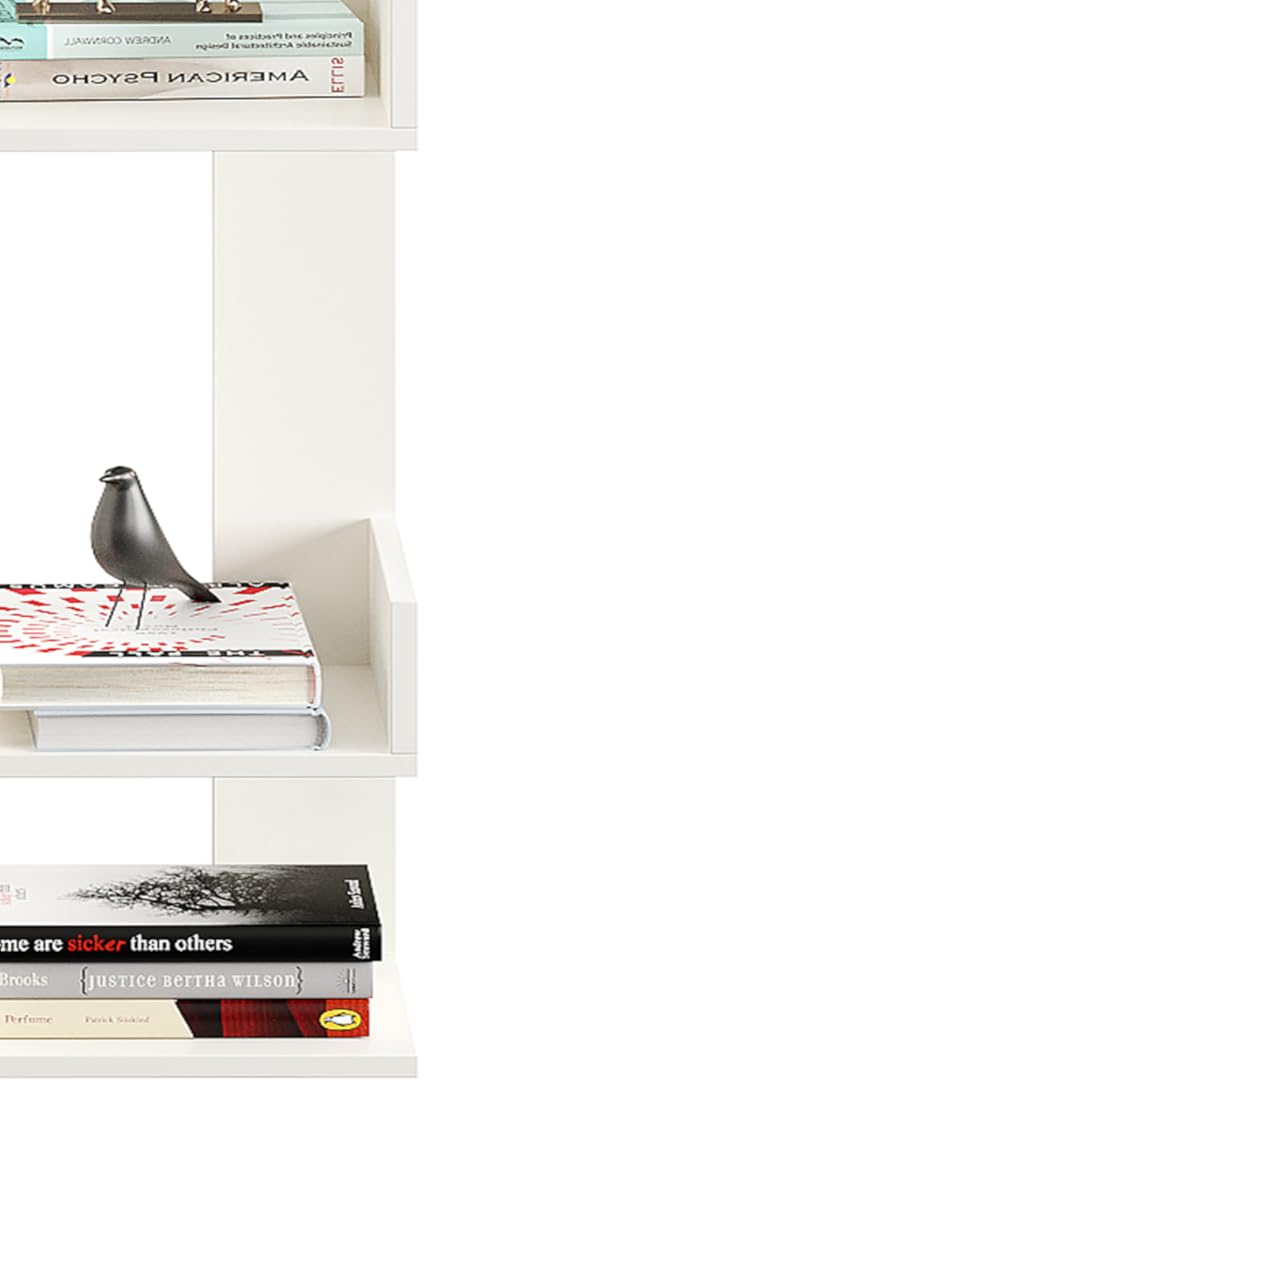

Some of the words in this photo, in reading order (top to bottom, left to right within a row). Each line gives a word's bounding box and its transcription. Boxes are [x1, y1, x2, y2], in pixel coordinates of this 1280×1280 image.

[32, 937, 64, 953] are
[67, 933, 127, 953] sicker
[129, 933, 172, 952] than
[173, 933, 234, 952] others
[0, 971, 49, 988] Brooks
[3, 1013, 54, 1025] Perfume
